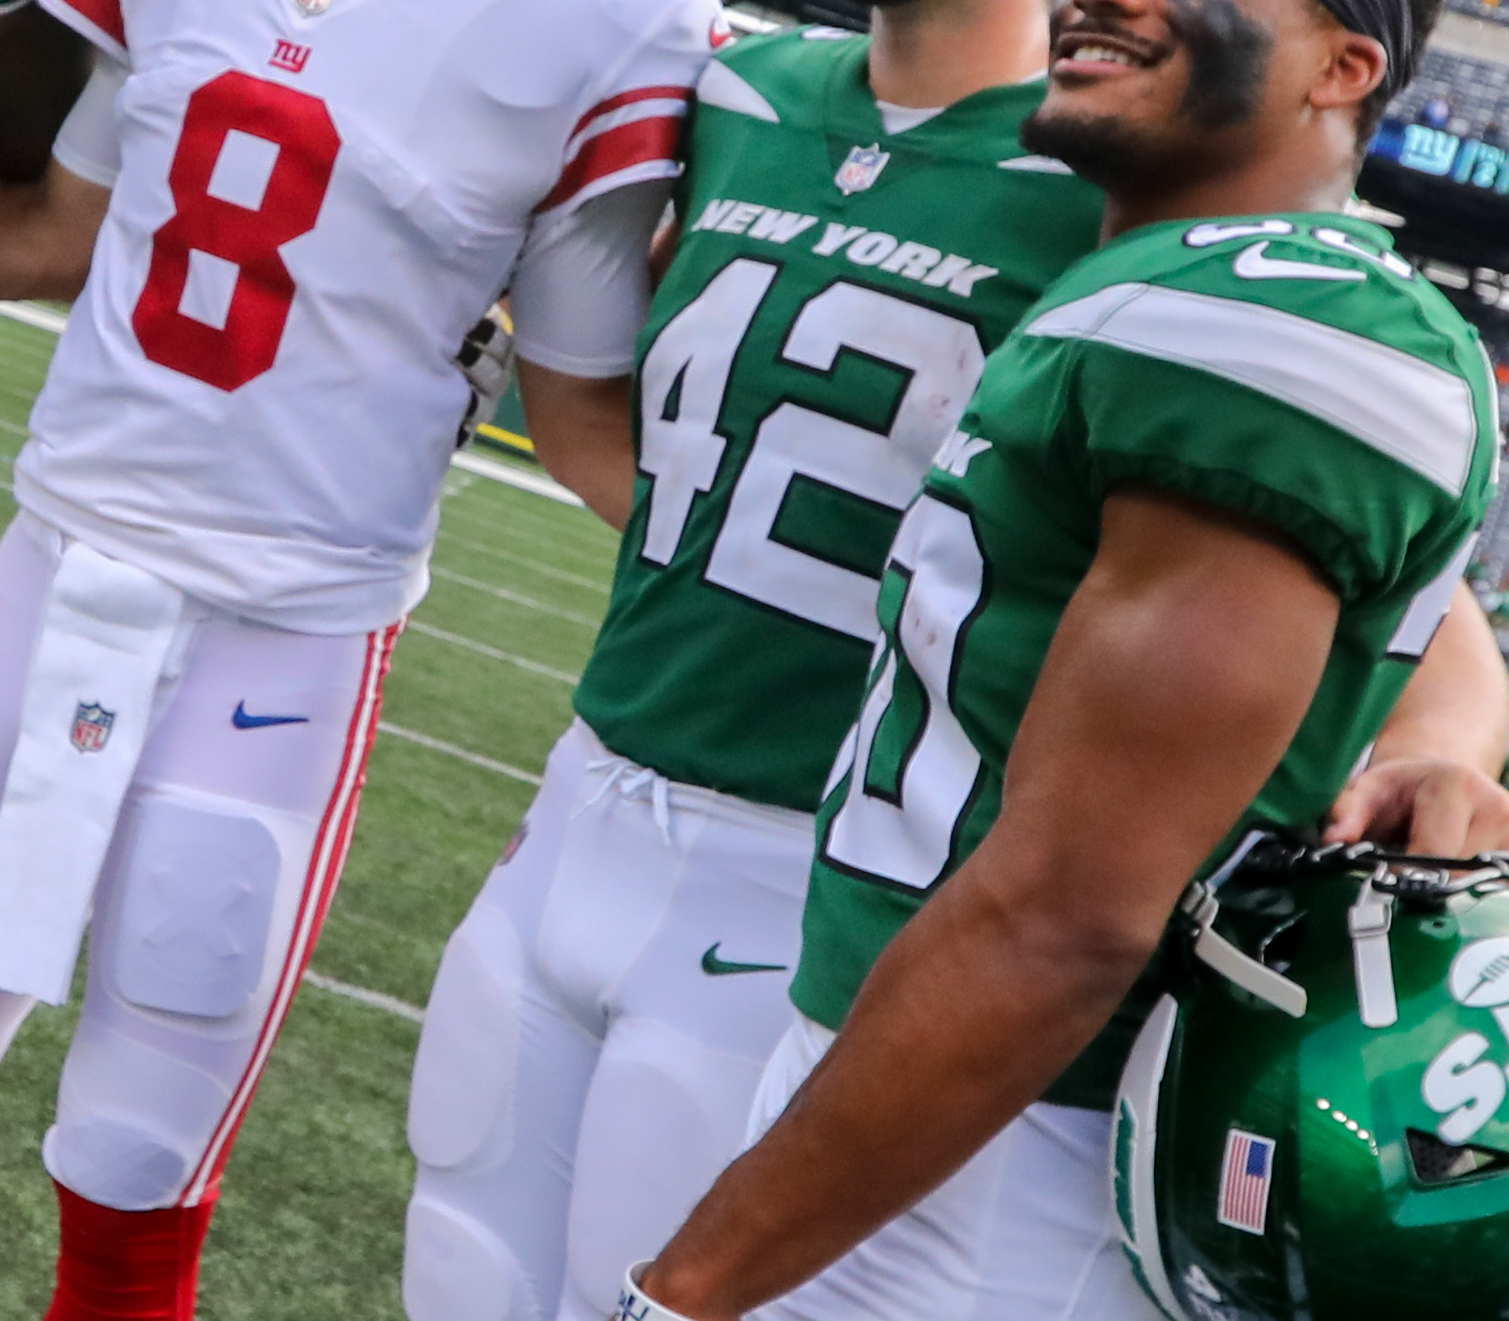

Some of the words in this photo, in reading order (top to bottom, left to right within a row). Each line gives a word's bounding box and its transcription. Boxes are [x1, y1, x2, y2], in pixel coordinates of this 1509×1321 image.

[130, 68, 343, 394] 8
[691, 197, 820, 245] NEW
[811, 221, 1000, 298] YORK
[637, 255, 989, 646] 42
